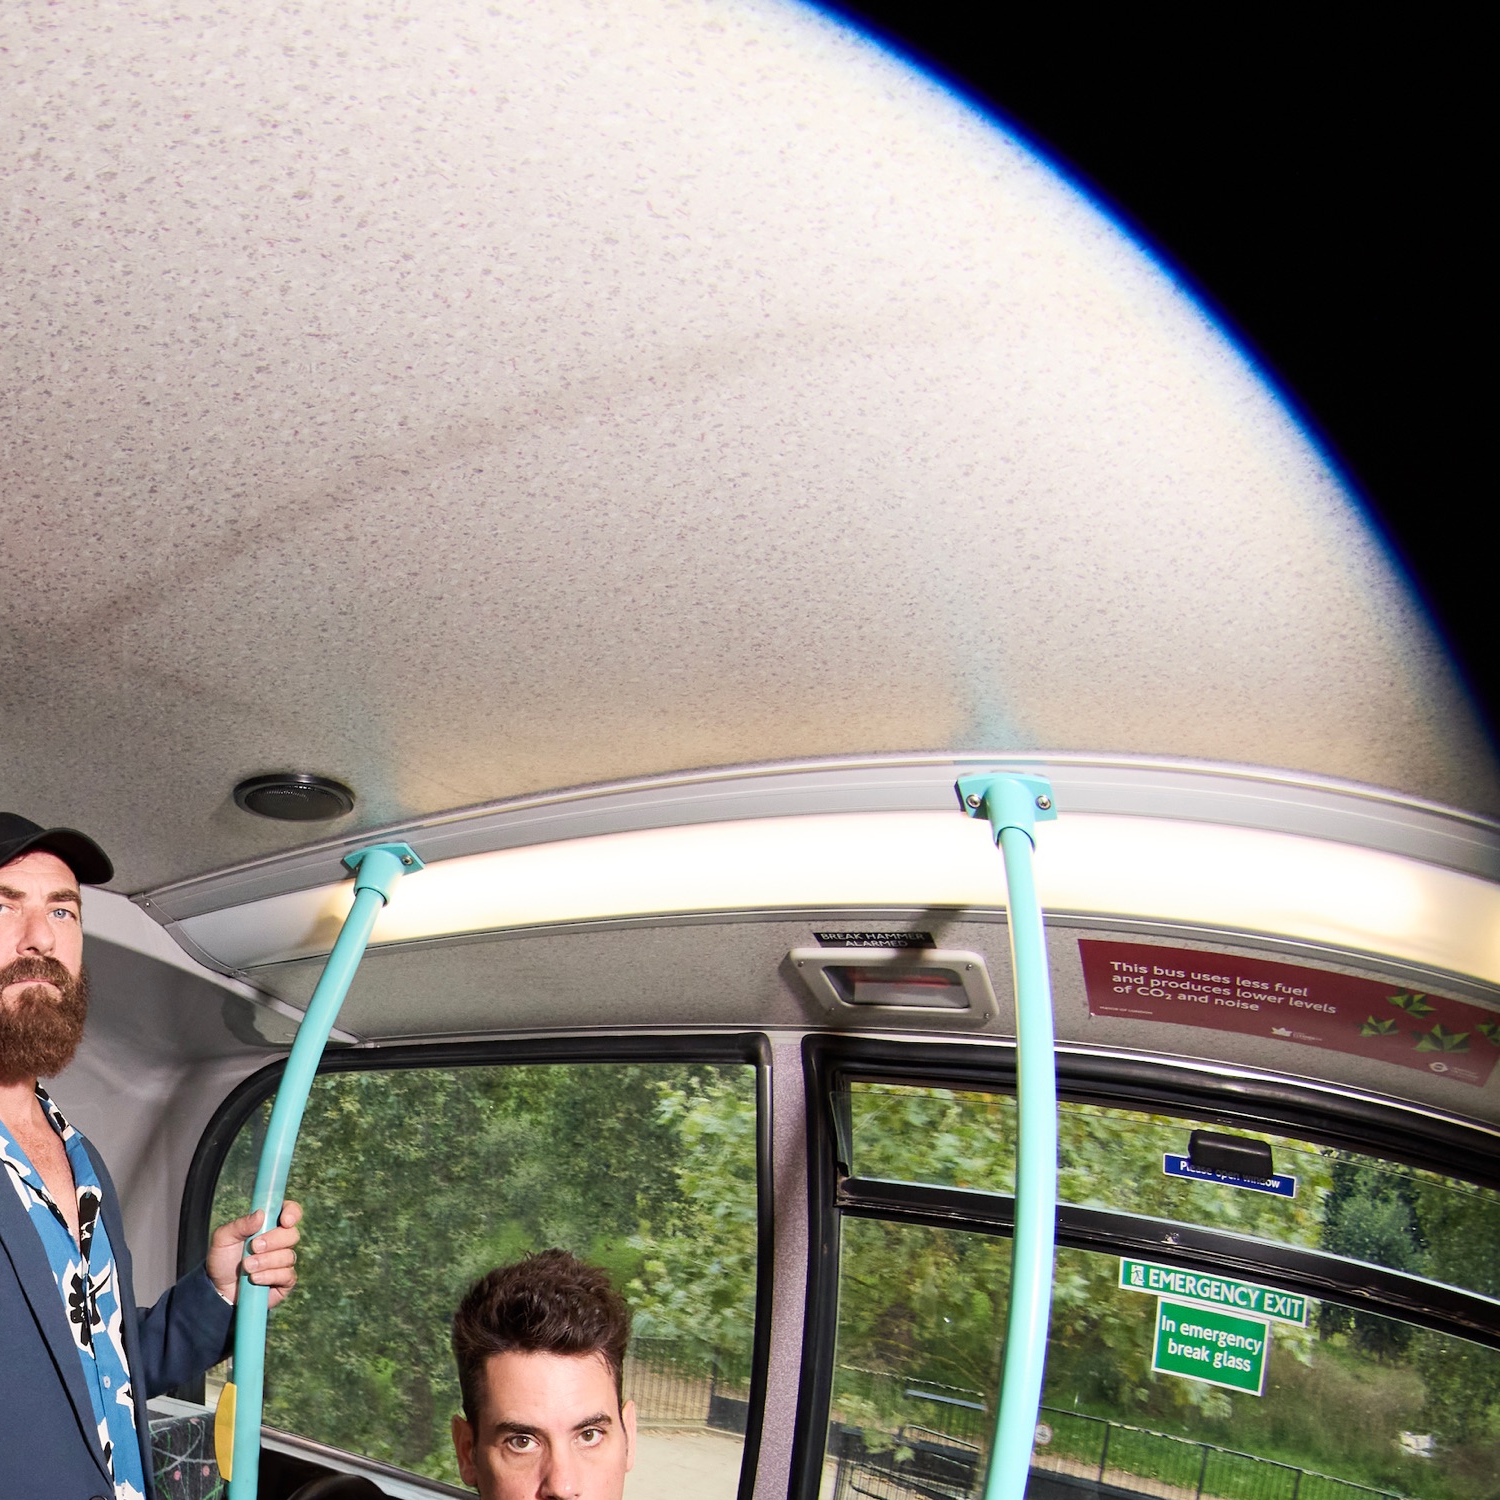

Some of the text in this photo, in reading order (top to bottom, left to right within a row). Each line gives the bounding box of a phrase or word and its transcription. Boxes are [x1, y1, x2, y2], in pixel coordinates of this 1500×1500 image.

[1110, 961, 1308, 997] This bus uses less fuel
[1112, 974, 1337, 1014] and produces lower levels
[1113, 985, 1132, 994] of
[1177, 992, 1209, 1004] and
[1214, 998, 1260, 1012] noise
[1149, 1268, 1303, 1319] EMERGENCY EXIT
[1161, 1315, 1262, 1355] In emergency
[1167, 1338, 1251, 1372] break glass
